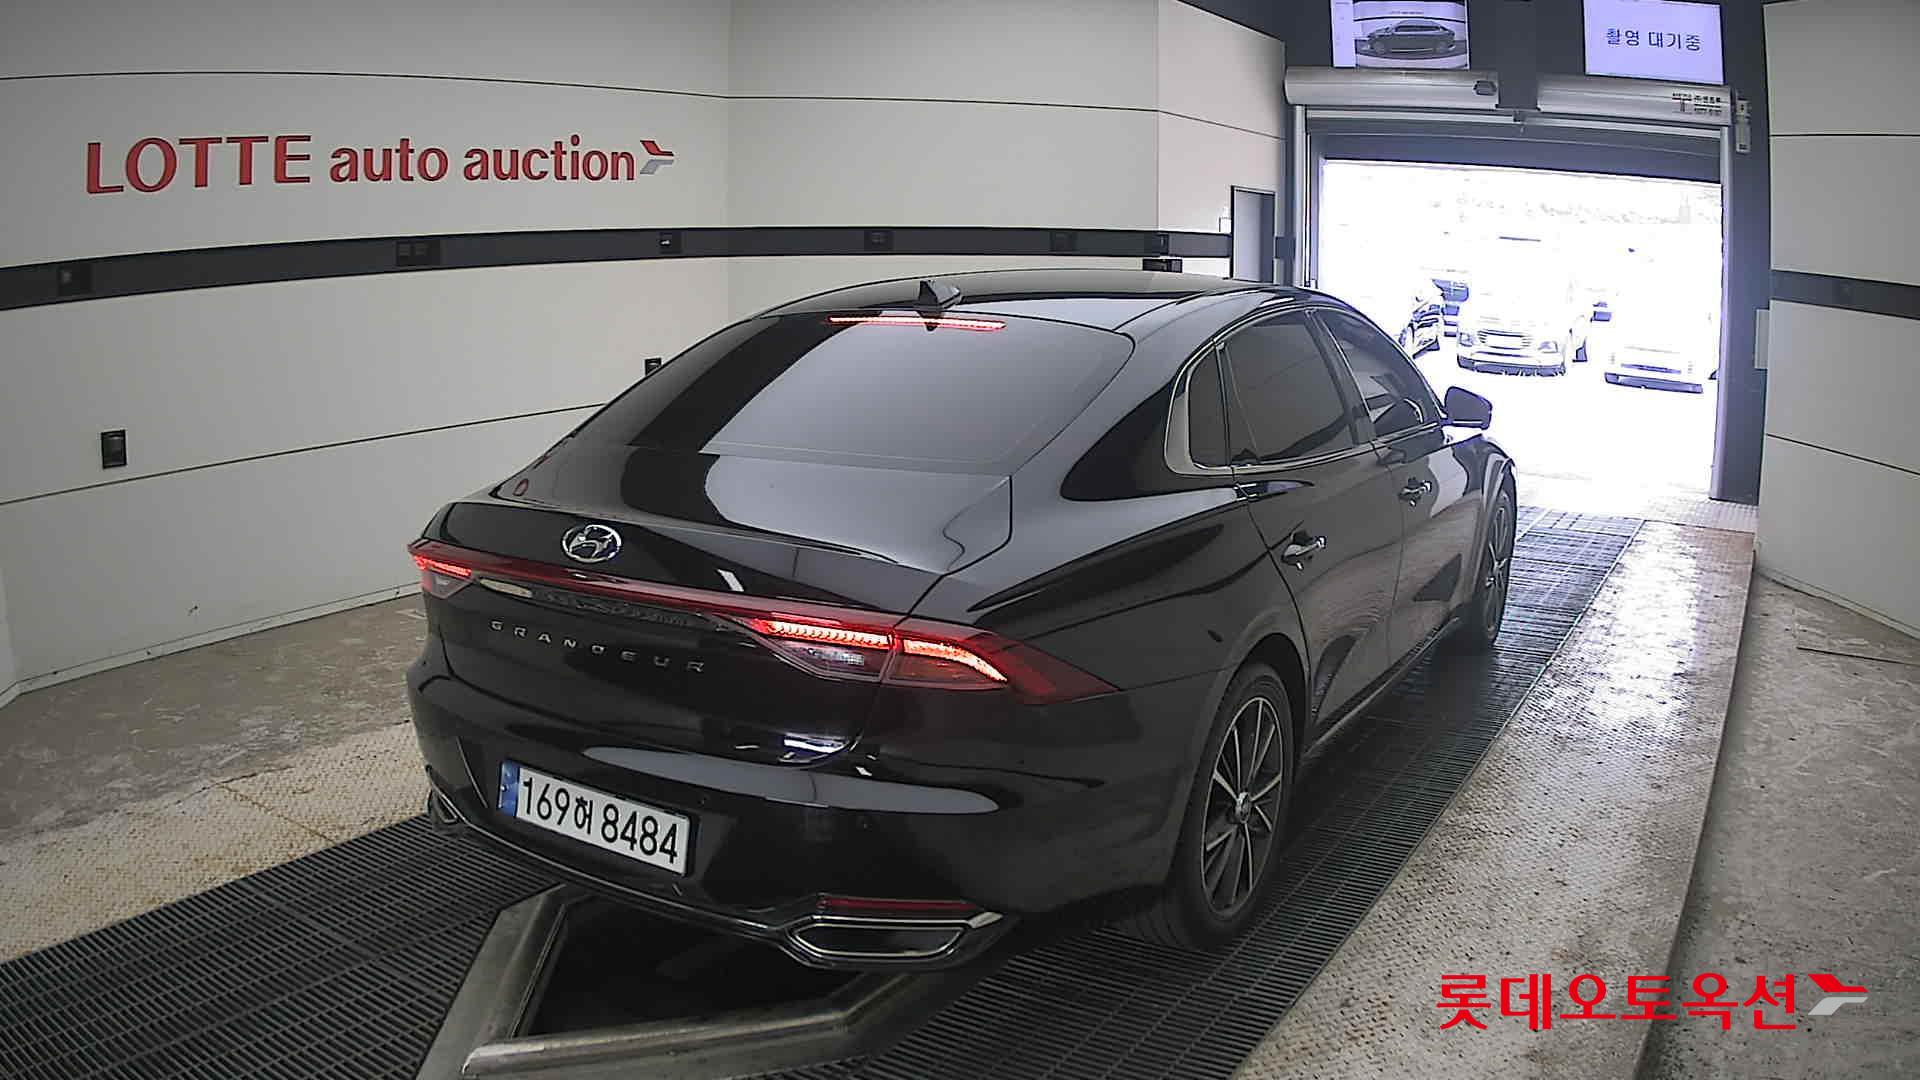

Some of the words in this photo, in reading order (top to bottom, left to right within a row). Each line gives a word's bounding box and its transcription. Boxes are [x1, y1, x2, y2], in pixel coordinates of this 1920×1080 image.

[1647, 31, 1701, 51] 대기중
[86, 134, 311, 194] LOTTE
[329, 137, 449, 183] auto
[463, 133, 635, 182] auction
[491, 620, 705, 673] GRANDEUR
[601, 802, 679, 865] 8484
